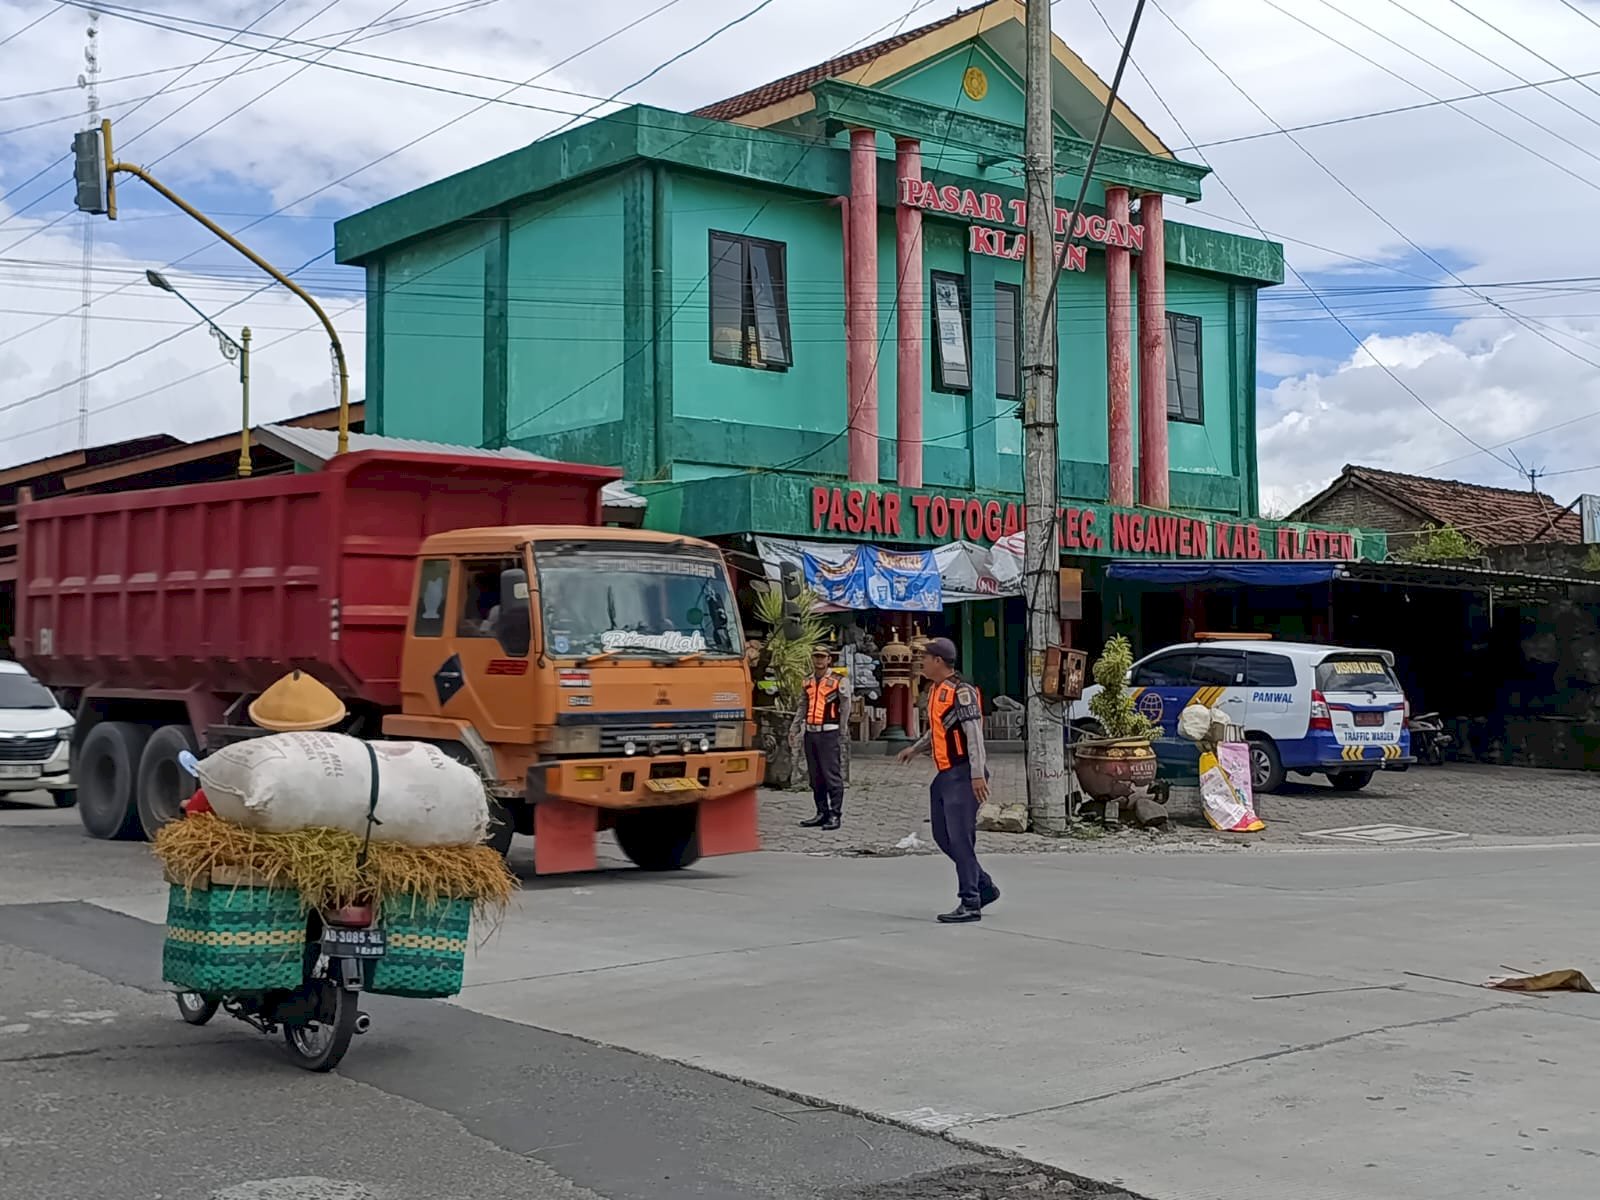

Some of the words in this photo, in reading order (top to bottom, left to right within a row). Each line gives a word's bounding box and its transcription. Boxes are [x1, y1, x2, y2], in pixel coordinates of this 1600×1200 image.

[902, 177, 1005, 222] PASAR
[1008, 199, 1145, 250] TTOGAN
[968, 225, 1088, 272] KLAEN
[811, 486, 901, 534] PASAR
[1112, 512, 1207, 557] NGAWEN
[1215, 521, 1267, 559] KAB.
[1277, 526, 1353, 560] KLATEN
[601, 630, 705, 653] Bismillah
[1252, 691, 1294, 704] PAMWAL
[1344, 731, 1370, 741] TRAFFIC
[1371, 731, 1394, 741] WARDEN
